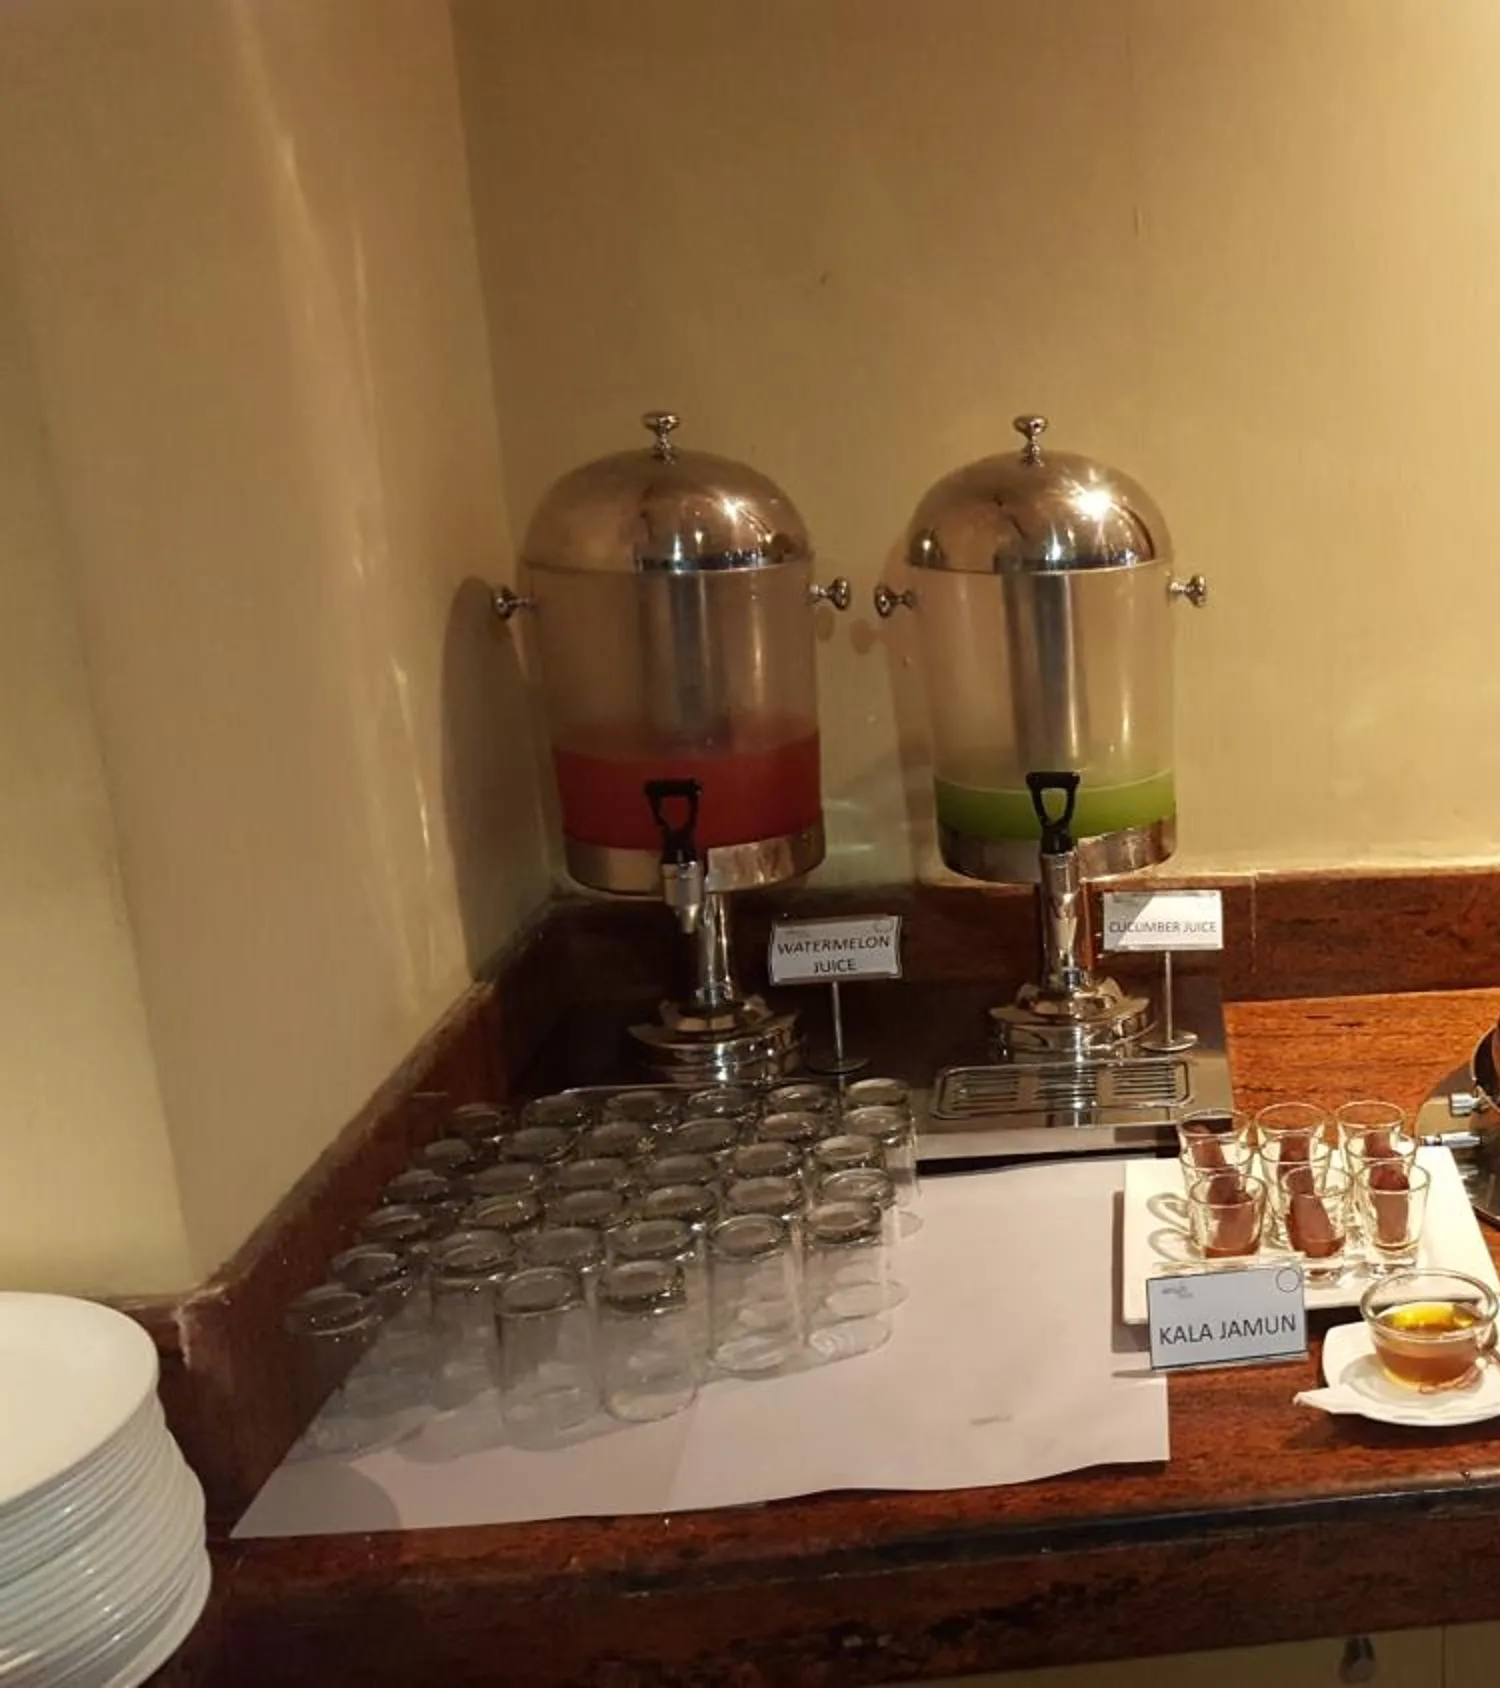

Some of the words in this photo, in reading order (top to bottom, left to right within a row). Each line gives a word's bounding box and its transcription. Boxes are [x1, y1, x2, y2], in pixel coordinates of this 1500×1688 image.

[1108, 921, 1180, 933] CUCUMBER
[1183, 921, 1217, 933] JUICE
[777, 935, 889, 955] WATERMELON
[813, 958, 857, 973] JUICE
[1159, 1323, 1214, 1345] KALA
[1219, 1313, 1297, 1341] JAMUN
